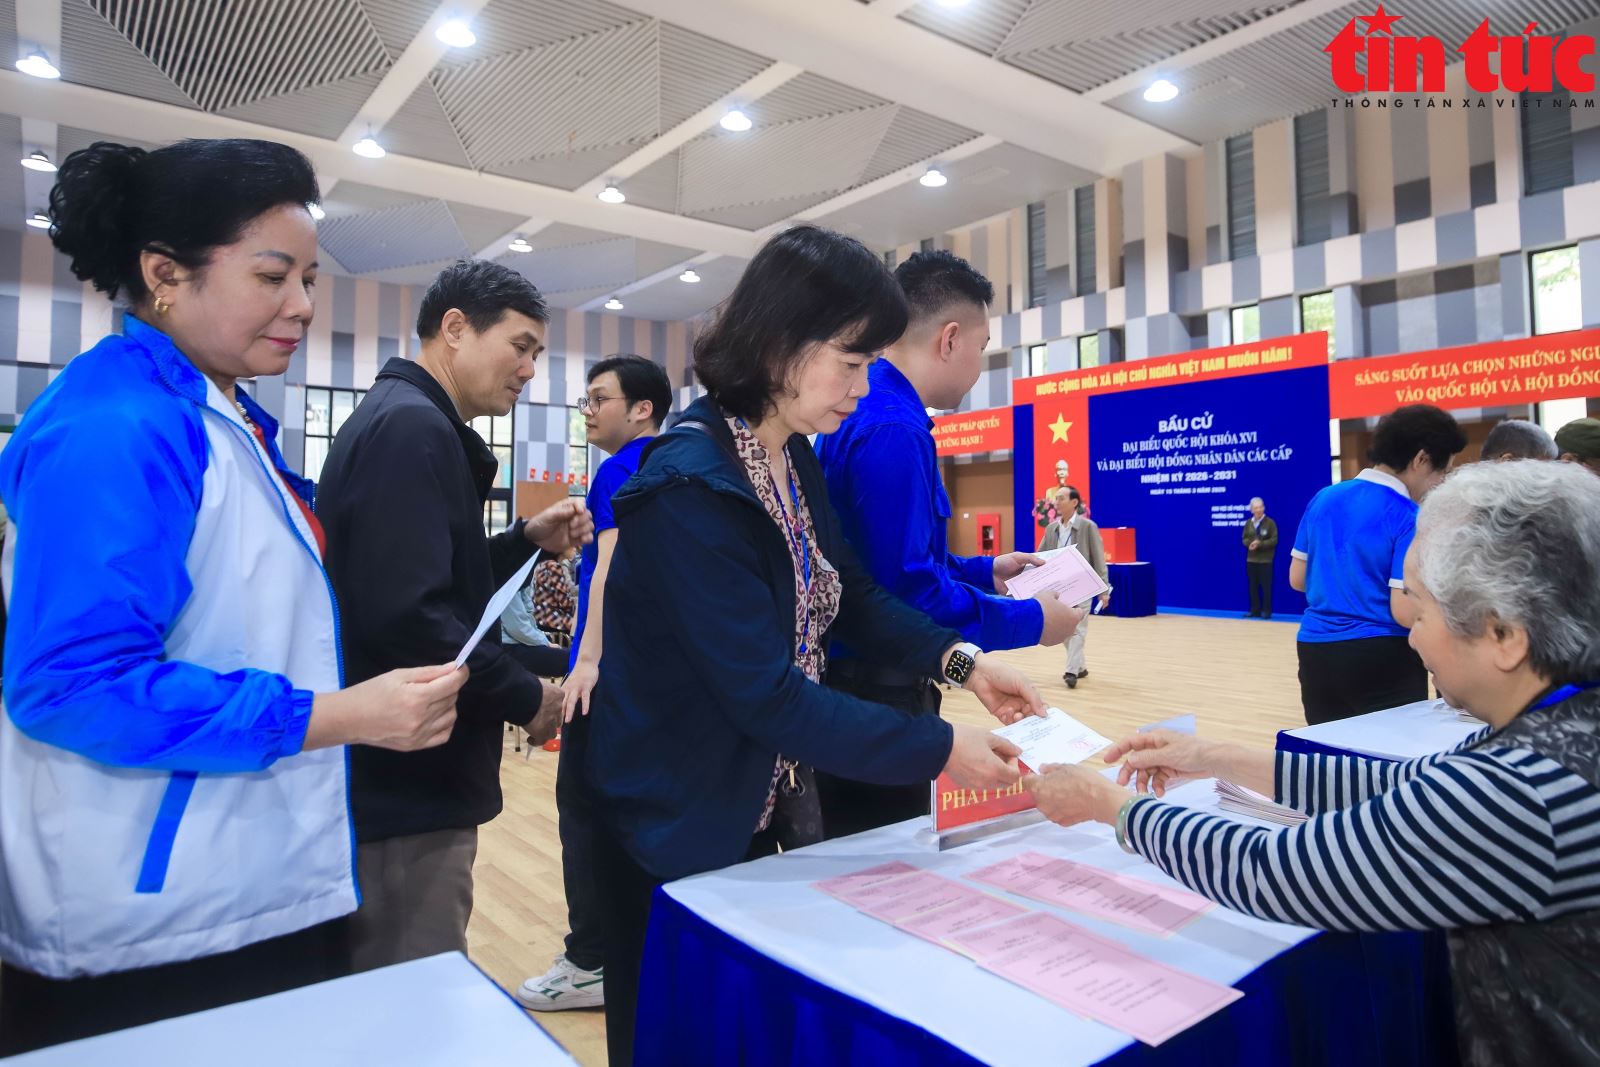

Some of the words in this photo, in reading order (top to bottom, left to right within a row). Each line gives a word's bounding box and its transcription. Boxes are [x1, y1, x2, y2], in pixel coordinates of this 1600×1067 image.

[1058, 378, 1080, 394] CỘNG
[1113, 369, 1127, 386] HỘI
[1129, 365, 1147, 382] CHỦ
[1149, 362, 1177, 379] NGHĨA
[1179, 359, 1199, 377] VIỆT
[1201, 356, 1225, 372] NAM
[1227, 350, 1259, 369] MUÔN
[1355, 369, 1389, 386] SÁNG
[1392, 362, 1428, 382] SUỐT
[1431, 362, 1459, 380] LỰA
[1462, 357, 1505, 375] CHỌN
[1508, 350, 1566, 369] NHỮNG
[1396, 385, 1424, 402] VÀO
[1426, 380, 1466, 402] QUỐC
[1470, 378, 1497, 398] HỘI
[1501, 374, 1521, 393] VÀ
[1525, 371, 1554, 393] HỘI
[1159, 414, 1188, 433] BẦU
[1191, 411, 1214, 430] CỬ
[1123, 441, 1138, 455] ĐẠI
[1140, 434, 1161, 451] BIỂU
[1162, 433, 1189, 452] QUỐC
[1190, 432, 1208, 450] HỘI
[1210, 430, 1238, 446] KHÓA
[1239, 431, 1257, 444] XVI
[1097, 458, 1108, 471] VÀ
[1109, 459, 1124, 472] ĐẠI
[1126, 453, 1147, 469] BIỂU
[1148, 453, 1165, 471] HỘI
[1166, 451, 1193, 467] ĐỒNG
[1194, 450, 1222, 465] NHÂN
[1224, 448, 1246, 464] DÂN
[1247, 446, 1269, 462] CÁC
[1270, 443, 1293, 461] CẤP
[1141, 472, 1170, 484] NHIỆM
